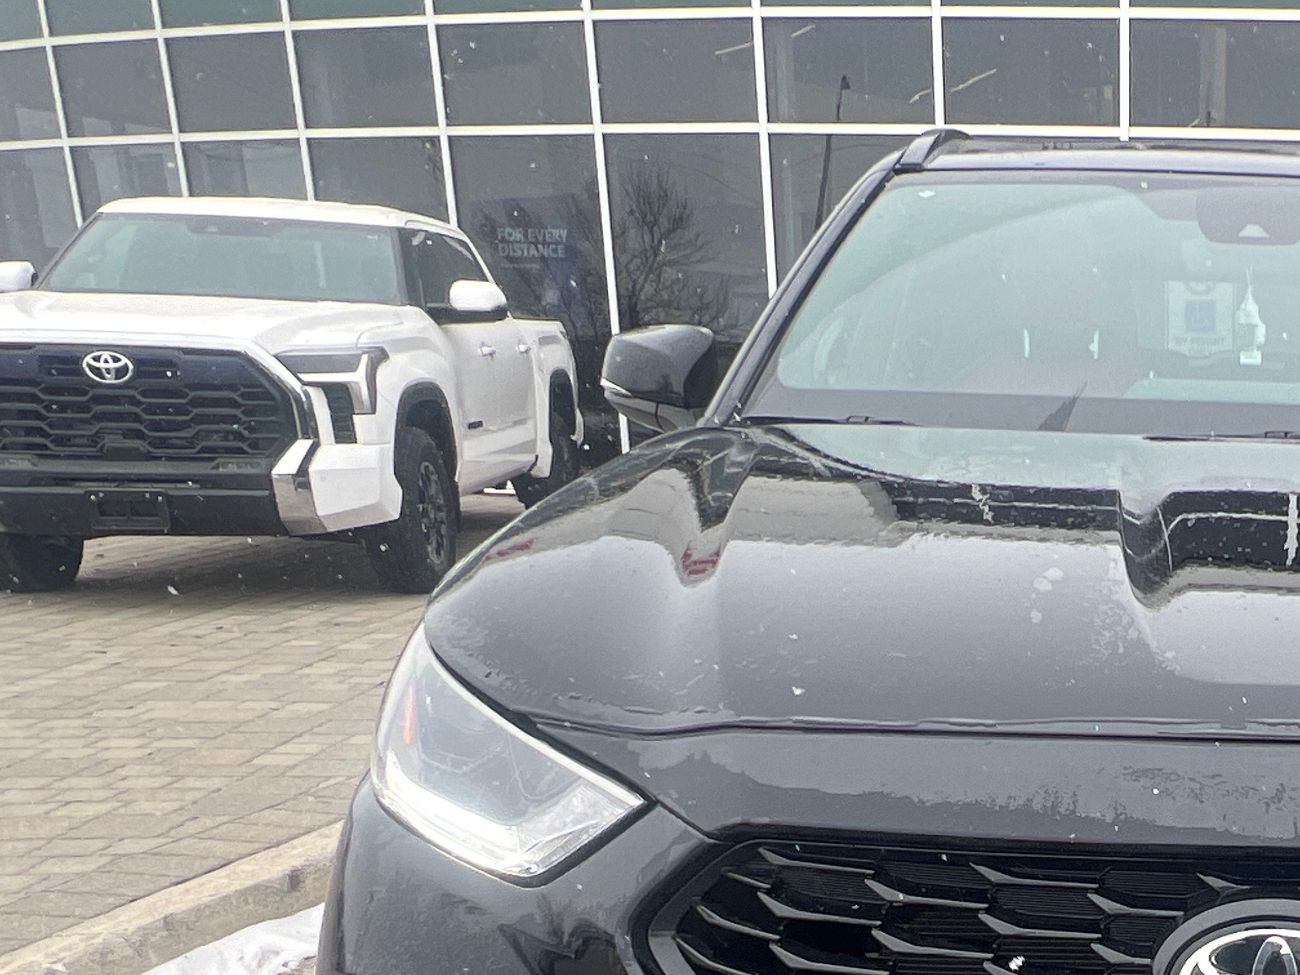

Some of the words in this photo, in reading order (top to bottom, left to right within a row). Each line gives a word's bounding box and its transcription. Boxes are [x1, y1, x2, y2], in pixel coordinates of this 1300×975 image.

[497, 227, 524, 241] FOR
[527, 227, 568, 242] EVERY
[498, 243, 565, 258] DISTANCE
